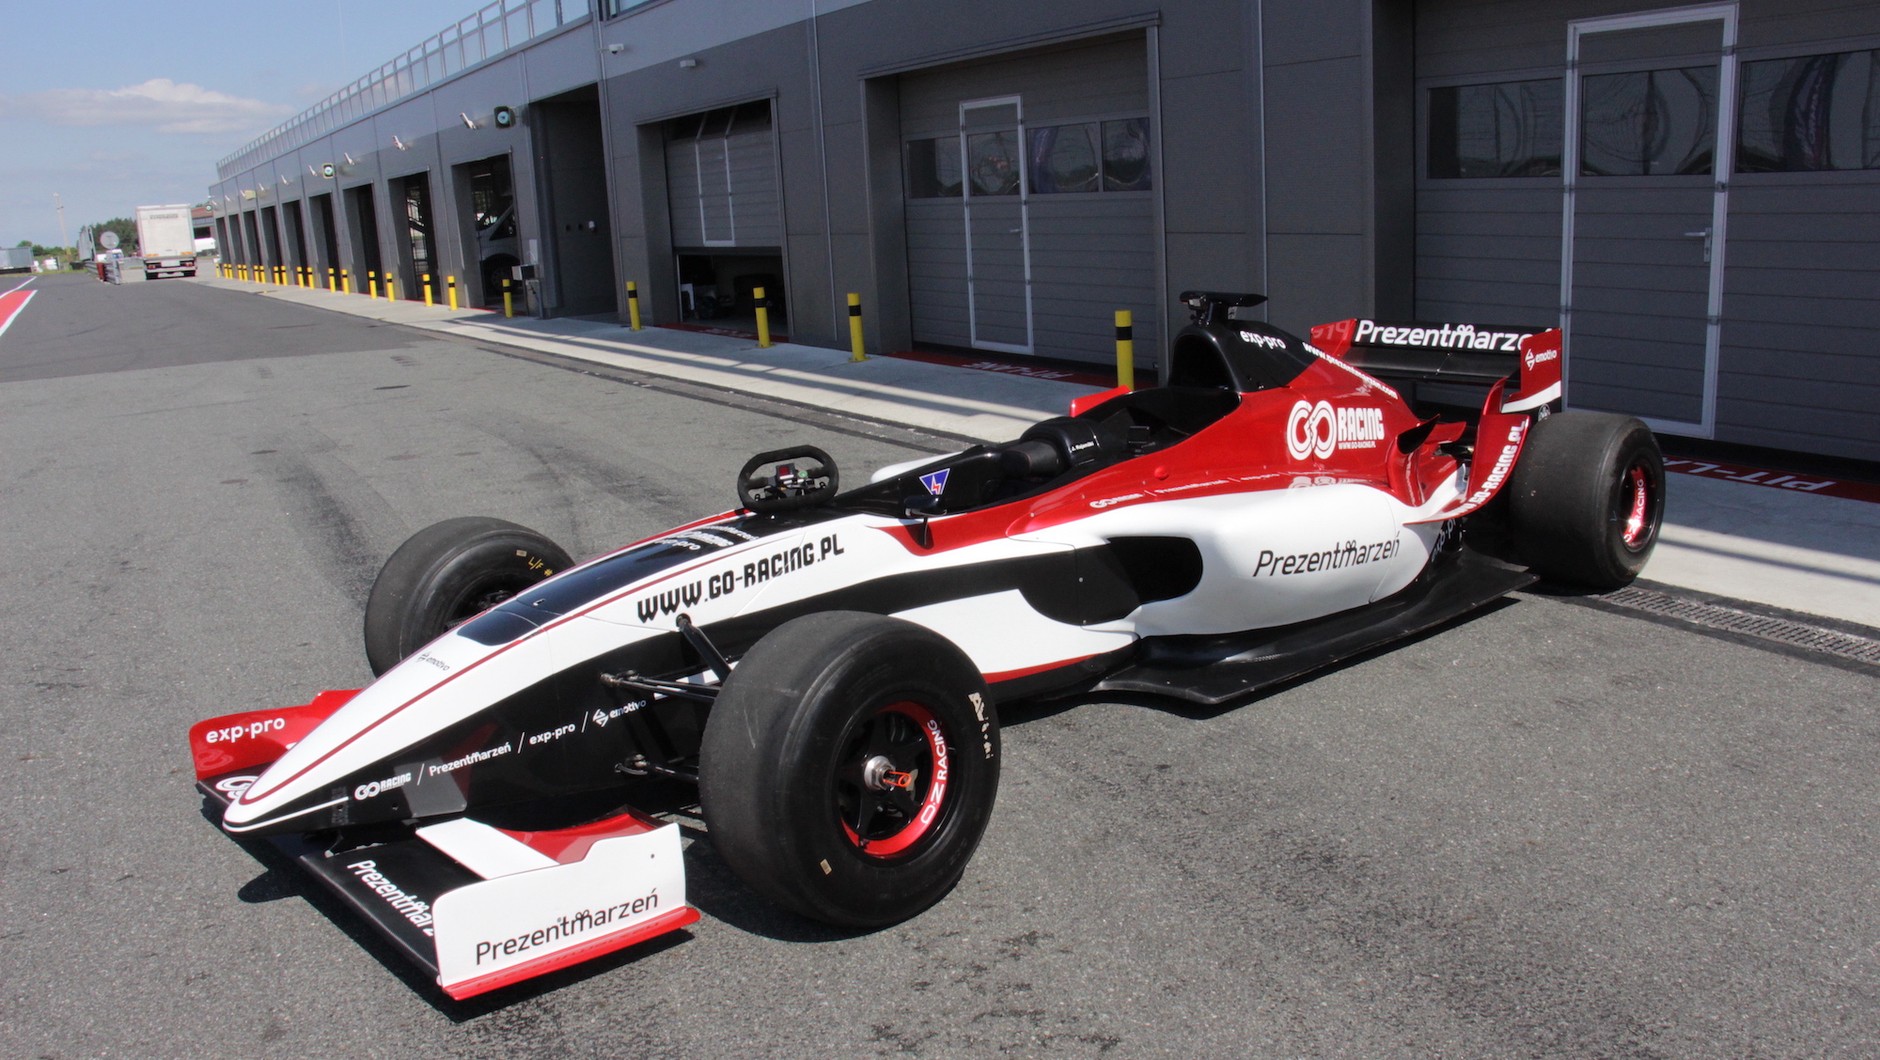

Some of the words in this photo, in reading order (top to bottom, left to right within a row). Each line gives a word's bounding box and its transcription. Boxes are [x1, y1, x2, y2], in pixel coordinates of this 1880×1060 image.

[1337, 407, 1385, 441] RACING
[637, 533, 845, 624] WWW.GO-RACING.PL
[380, 772, 411, 792] RACING
[609, 698, 647, 719] emotivo
[927, 719, 949, 781] RACING
